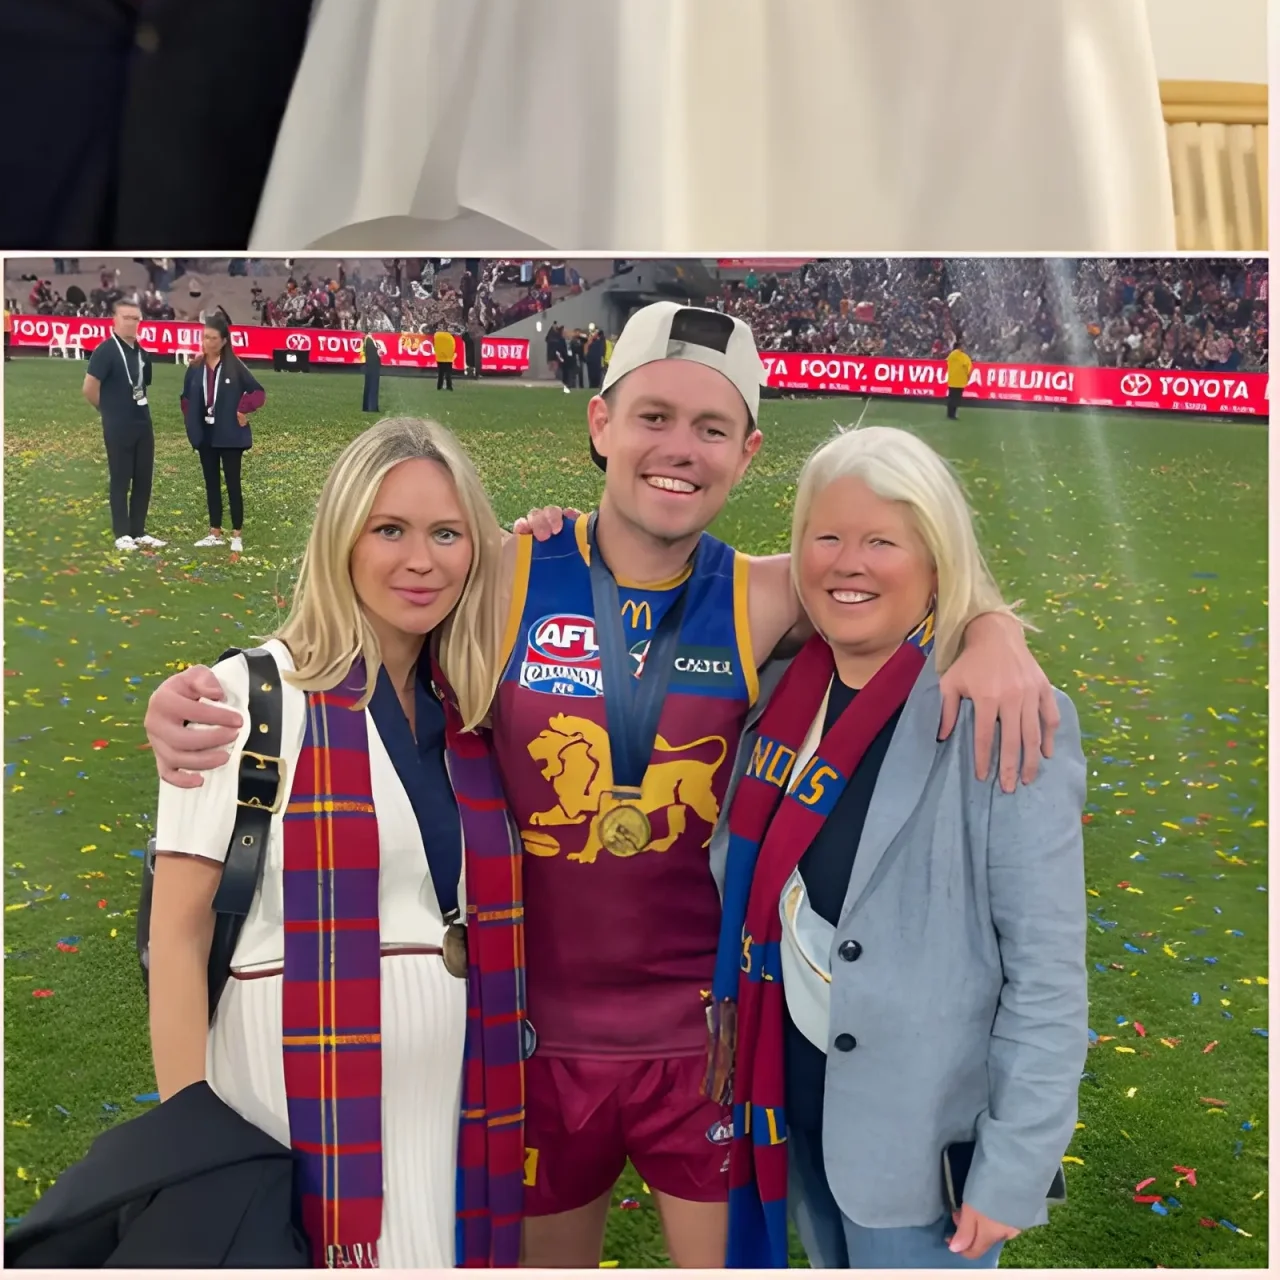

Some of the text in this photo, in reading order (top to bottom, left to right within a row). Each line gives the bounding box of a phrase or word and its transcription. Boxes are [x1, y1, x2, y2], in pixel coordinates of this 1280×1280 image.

[874, 363, 905, 382] OH
[1160, 376, 1249, 399] TOYOTA
[534, 623, 599, 651] AFL
